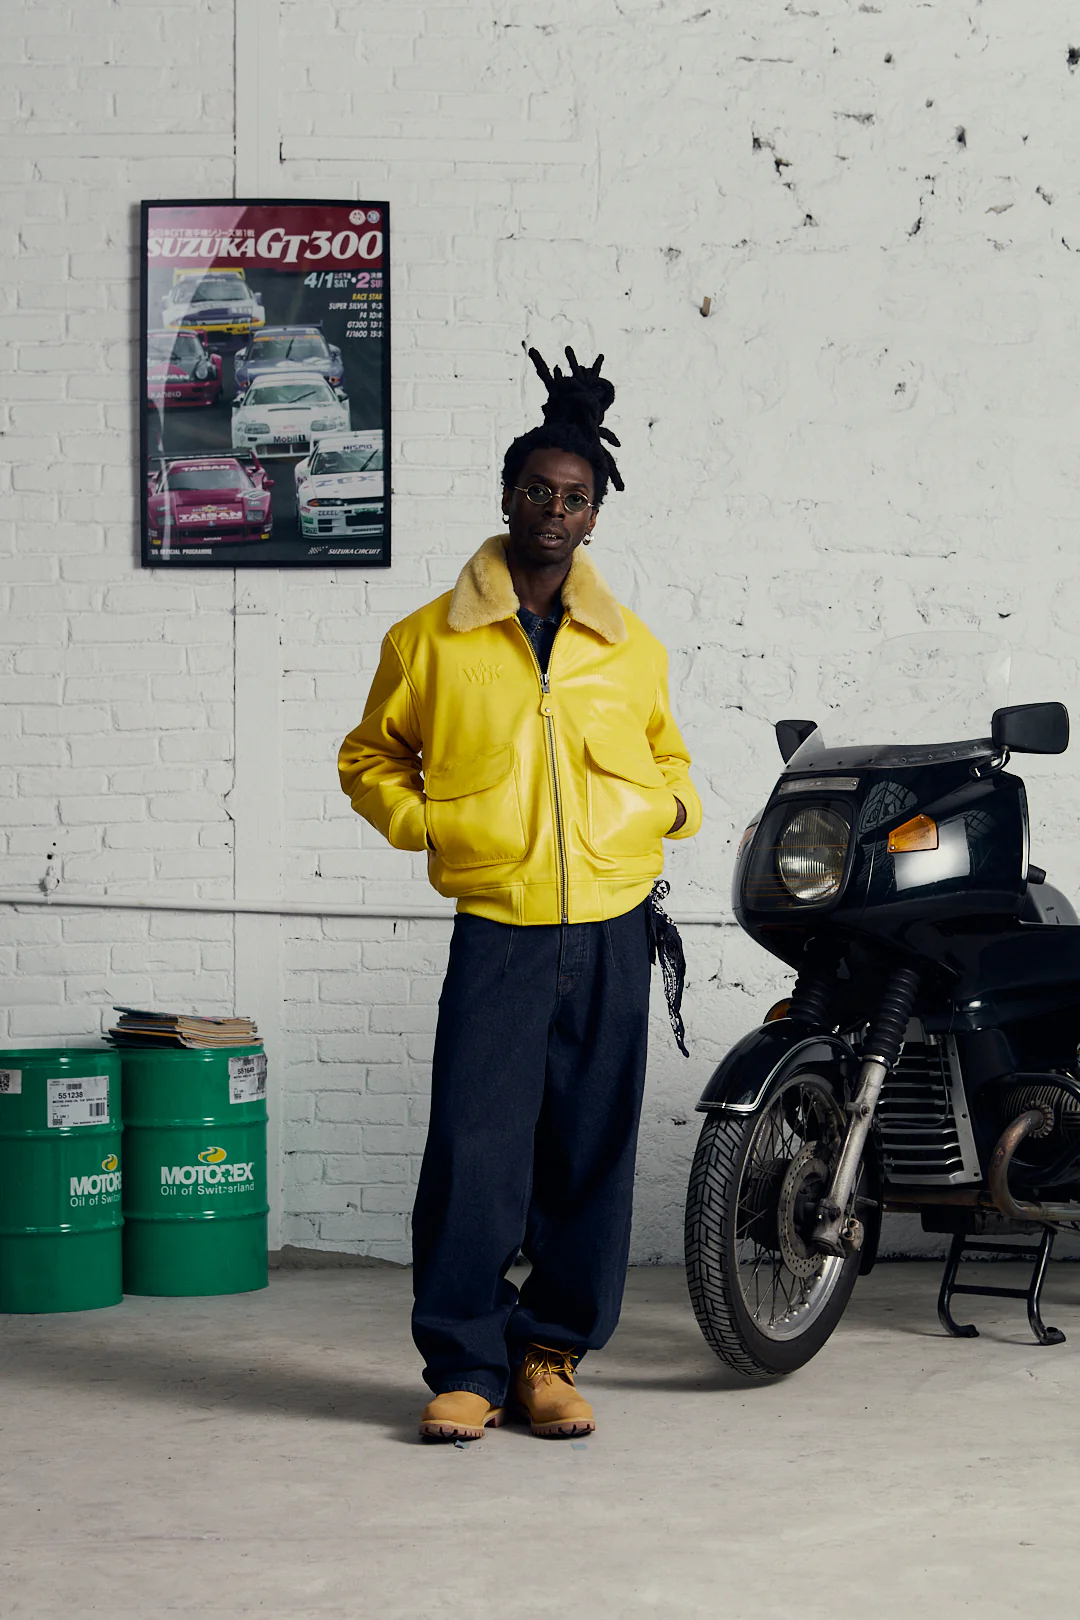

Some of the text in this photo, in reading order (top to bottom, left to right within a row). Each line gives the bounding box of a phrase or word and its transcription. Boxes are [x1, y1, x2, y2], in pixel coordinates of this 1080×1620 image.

[303, 272, 334, 288] 4/1
[334, 280, 348, 288] SAT
[328, 302, 384, 310] SUPER SILVIA 9:3
[347, 321, 384, 329] GT300 13:1
[345, 330, 368, 338] FJ1600
[316, 475, 383, 488] ZEX
[179, 511, 243, 522] TAISAN
[160, 1162, 254, 1185] MOTOREX
[160, 1186, 176, 1195] Oil
[181, 1185, 193, 1195] of
[70, 1197, 85, 1207] Oil
[89, 1195, 98, 1205] of
